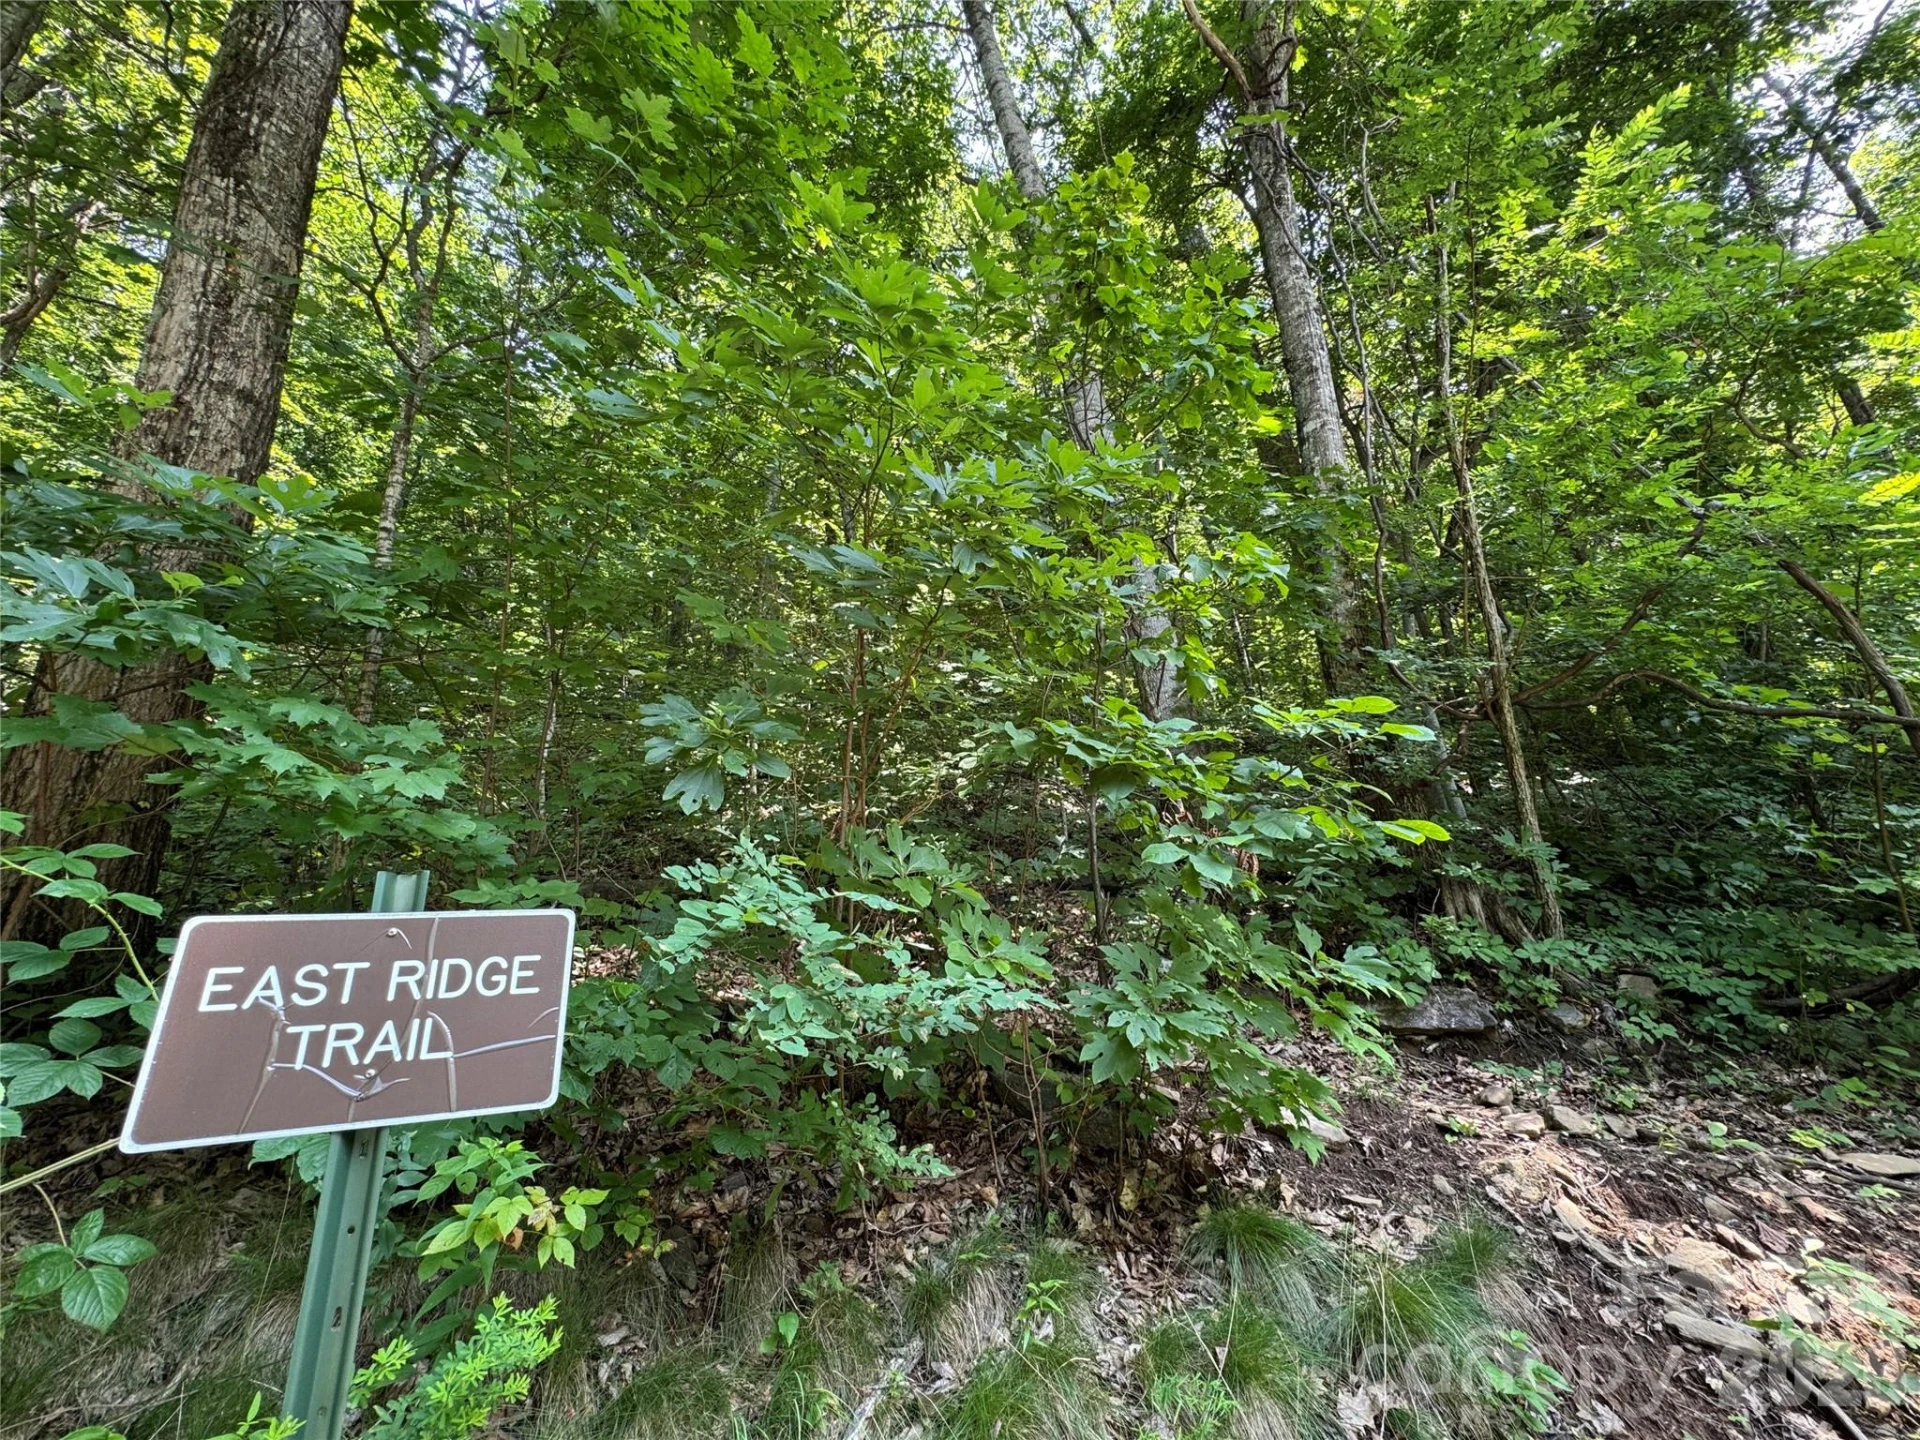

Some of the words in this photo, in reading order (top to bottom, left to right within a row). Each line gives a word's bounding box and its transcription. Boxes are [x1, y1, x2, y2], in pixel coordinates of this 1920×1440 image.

[198, 961, 371, 1012] EAST
[386, 954, 542, 1003] RIDGE
[286, 1017, 453, 1070] TRAIL
